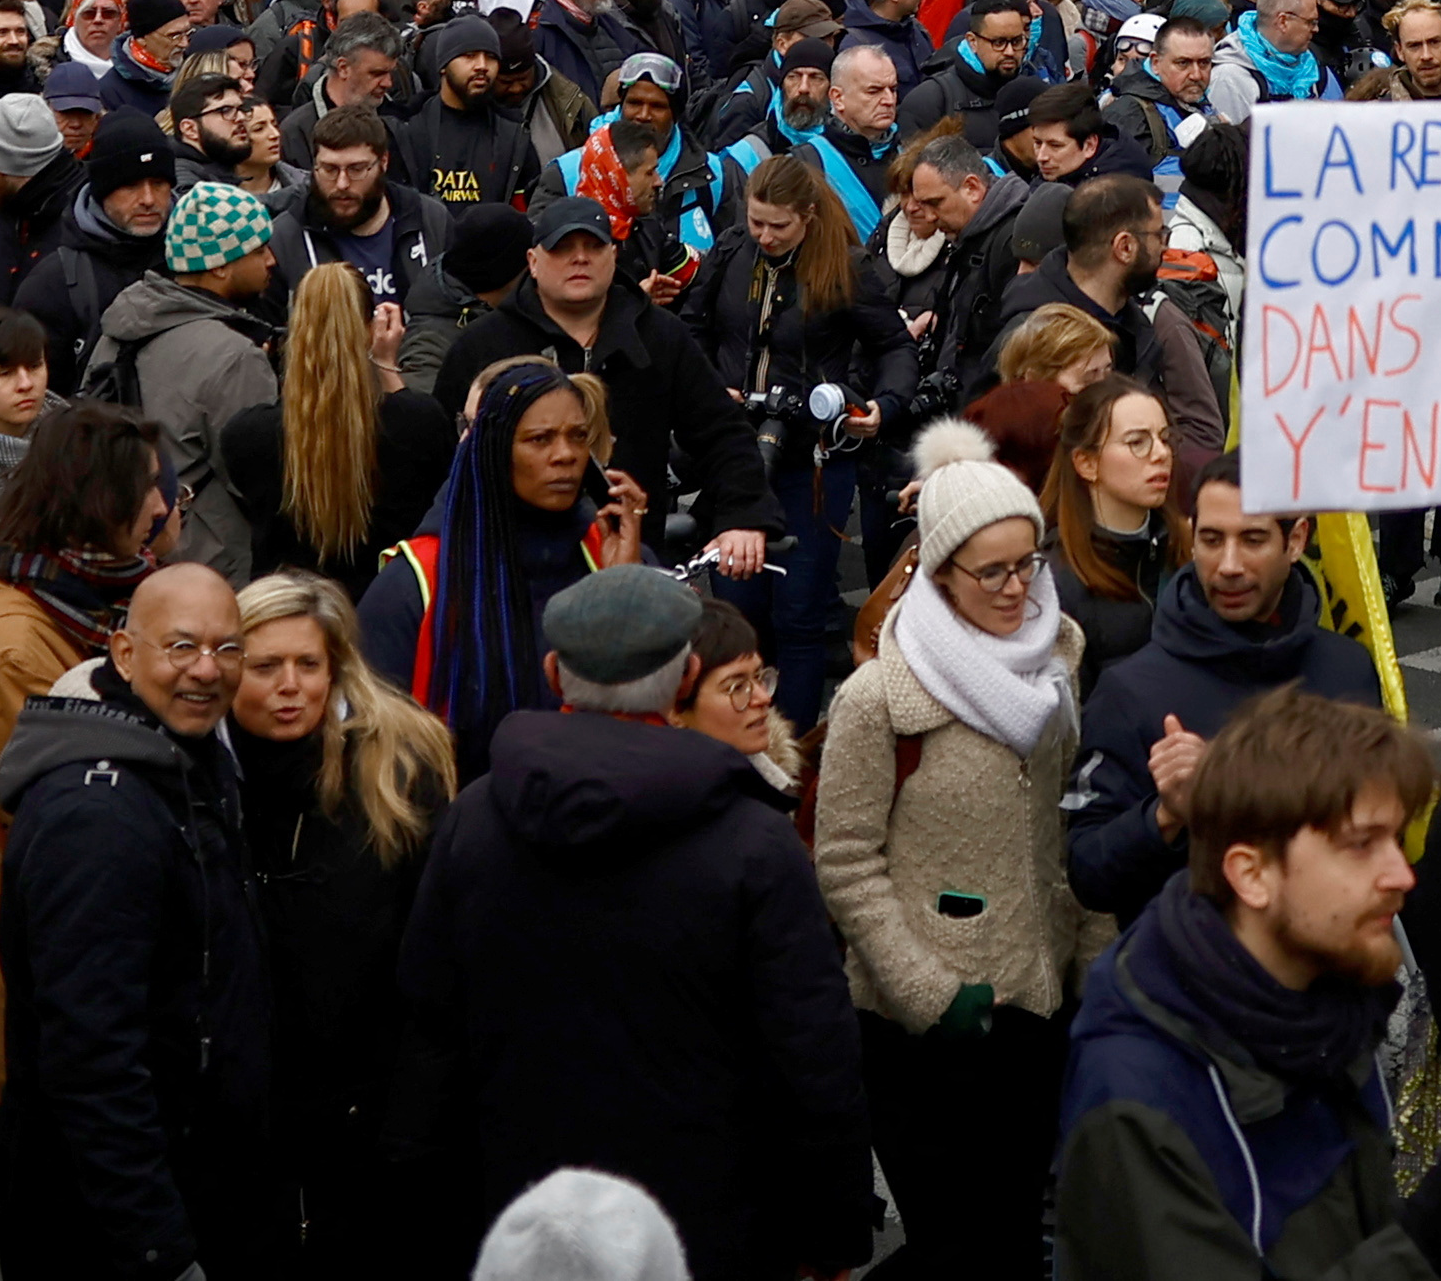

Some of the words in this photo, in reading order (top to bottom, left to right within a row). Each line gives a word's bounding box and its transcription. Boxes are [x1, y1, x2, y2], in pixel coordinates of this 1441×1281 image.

[1262, 122, 1364, 200] LA
[1262, 294, 1422, 397] DANS
[1275, 392, 1439, 501] Y'EN
